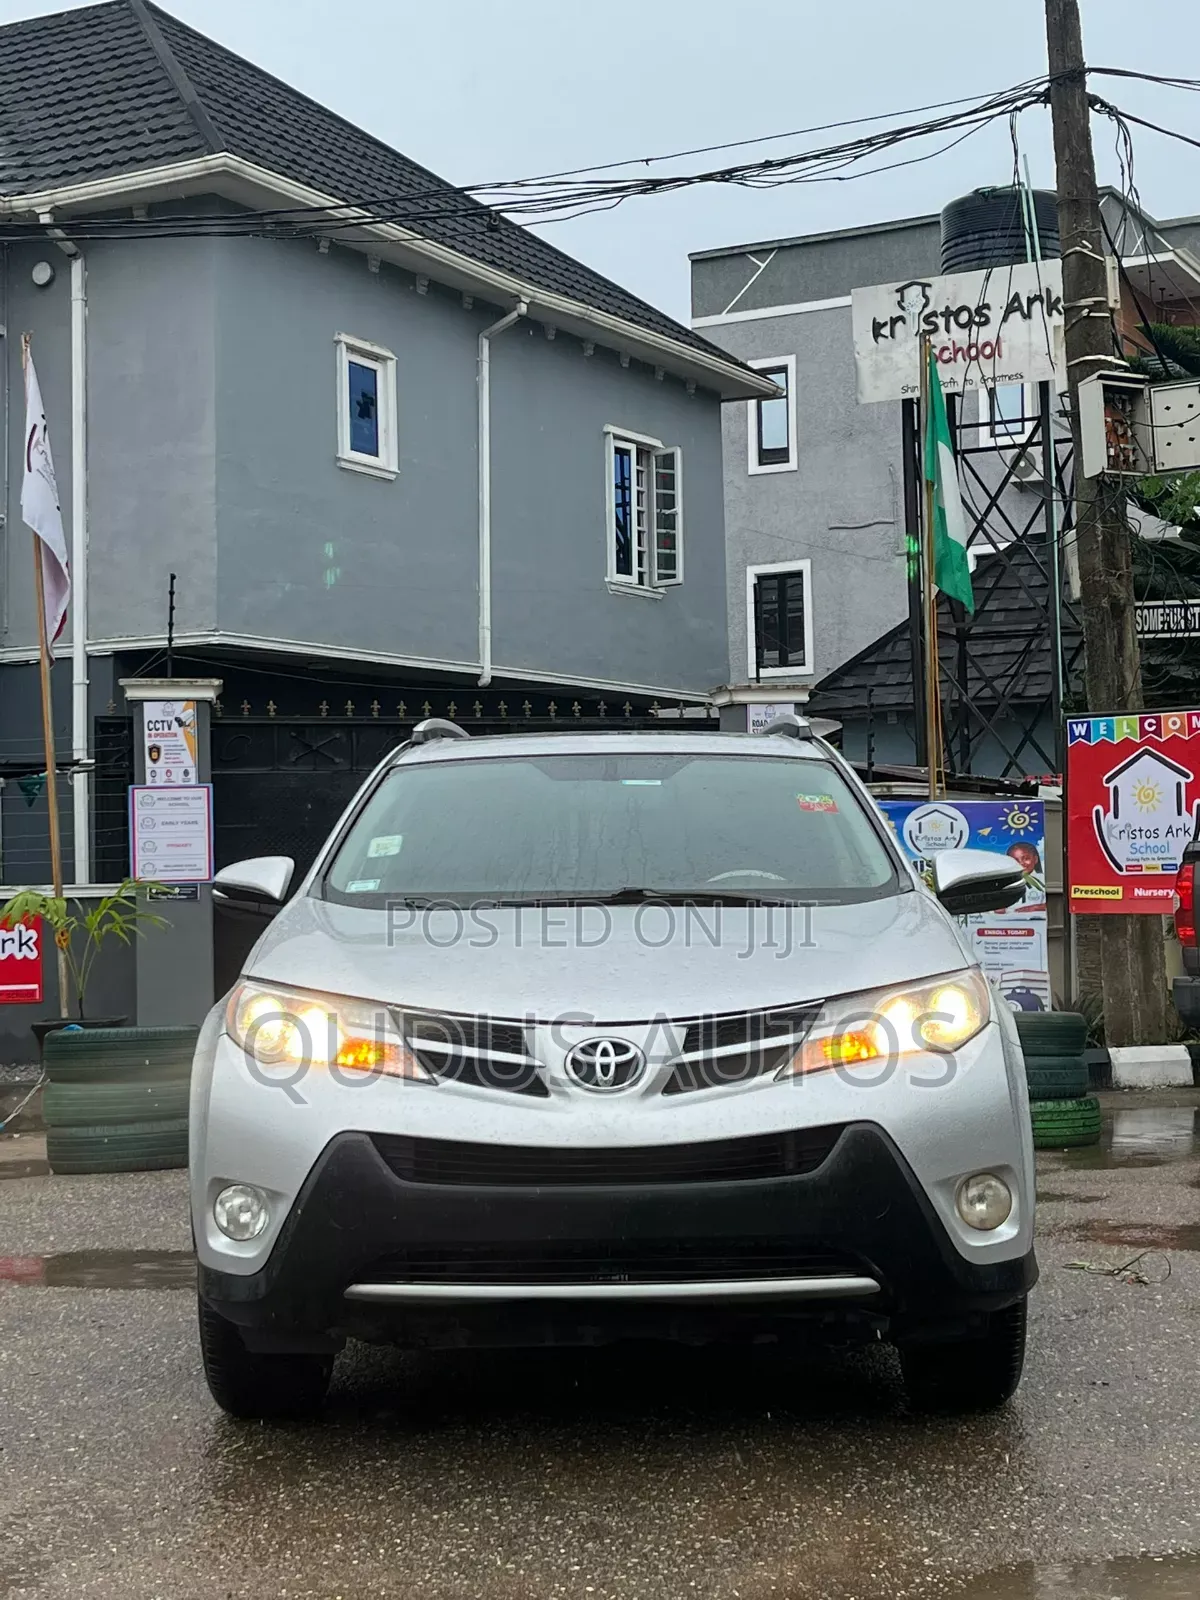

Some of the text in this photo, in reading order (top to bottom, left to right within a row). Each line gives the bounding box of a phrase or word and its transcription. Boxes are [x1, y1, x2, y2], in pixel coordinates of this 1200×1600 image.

[1003, 287, 1063, 323] Ark
[1135, 607, 1185, 632] SOMEFUN
[147, 720, 173, 731] CCTV
[1106, 821, 1192, 845] Kristos Ark
[1130, 841, 1170, 855] School
[1073, 887, 1175, 899] Preschool Nursery
